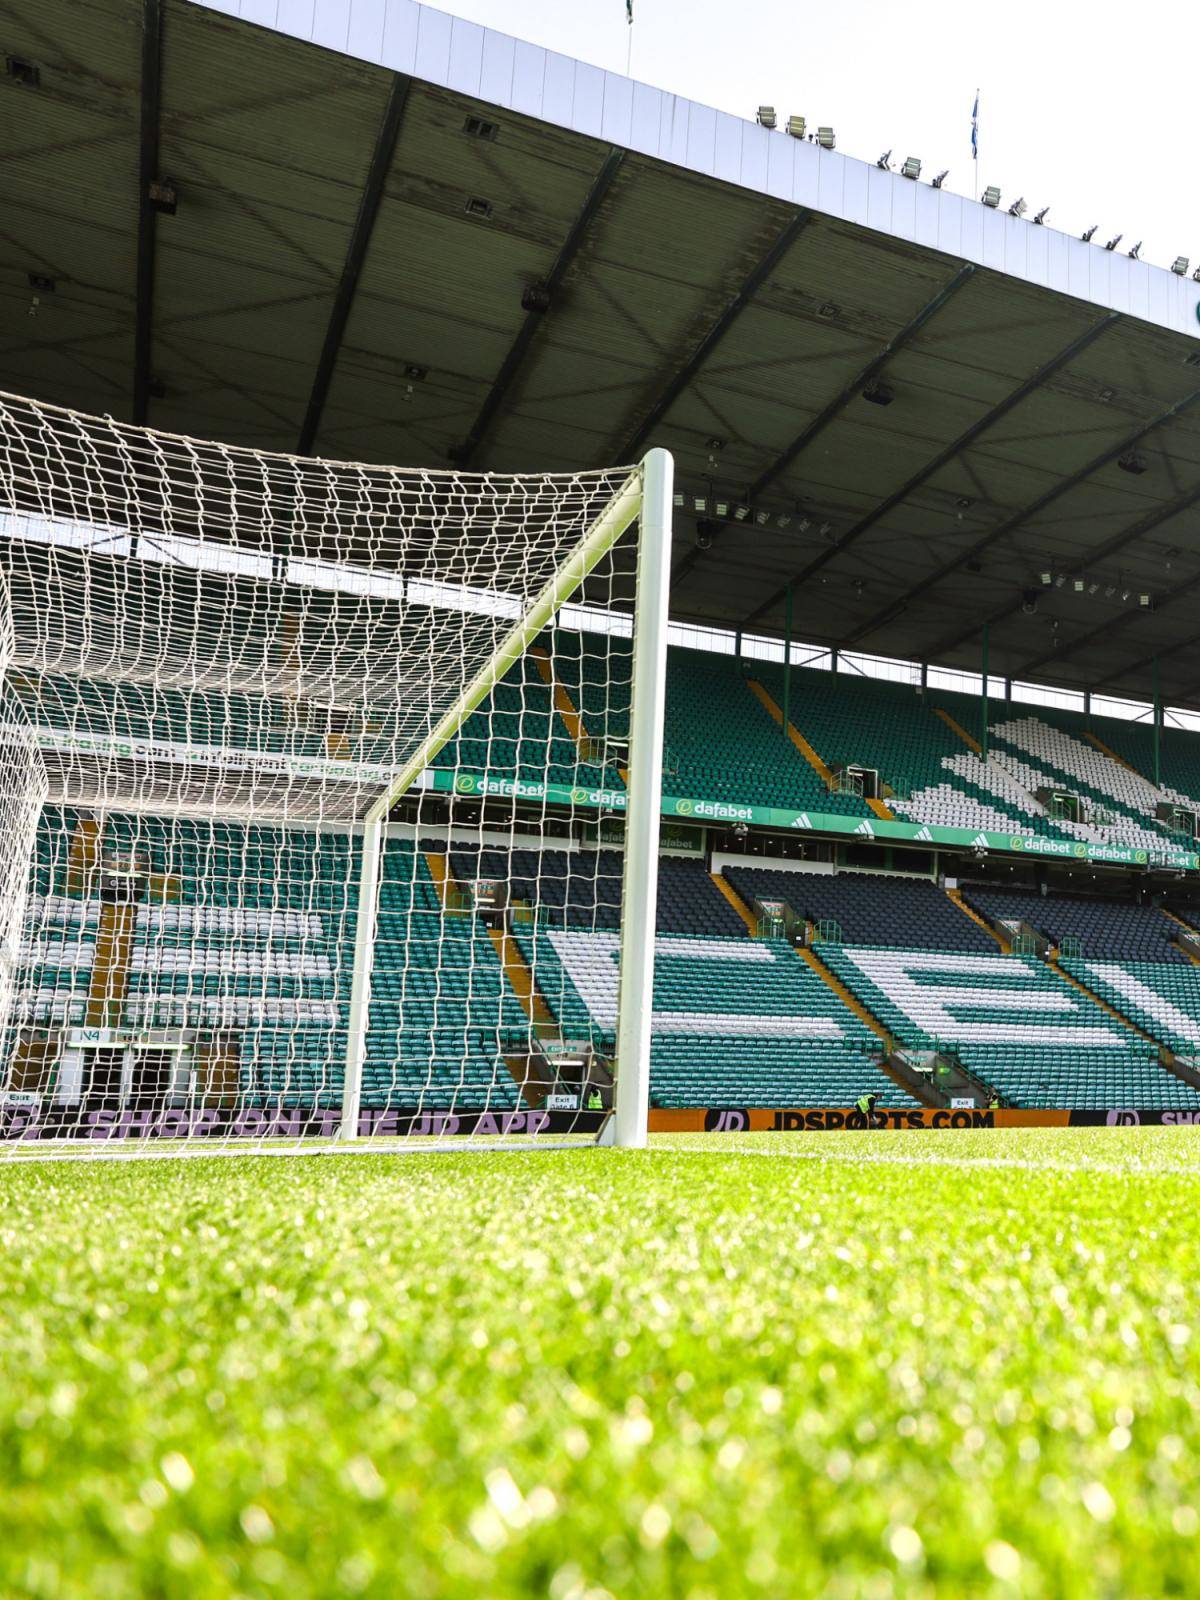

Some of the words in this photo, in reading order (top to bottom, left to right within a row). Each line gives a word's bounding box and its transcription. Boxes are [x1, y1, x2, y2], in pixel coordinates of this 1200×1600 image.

[477, 778, 544, 796] dafabet
[589, 790, 627, 809] dafa
[694, 801, 753, 820] dafabet
[660, 837, 693, 849] afabet
[1024, 836, 1070, 854] dafabet
[1087, 844, 1132, 860] dafabet
[85, 1108, 220, 1139] SHOP
[234, 1108, 301, 1137] ON
[315, 1109, 399, 1136] THE
[411, 1110, 460, 1136] JD
[473, 1110, 550, 1135] APP
[711, 1111, 745, 1132] JD
[768, 1111, 995, 1131] JDSPORTS.COM
